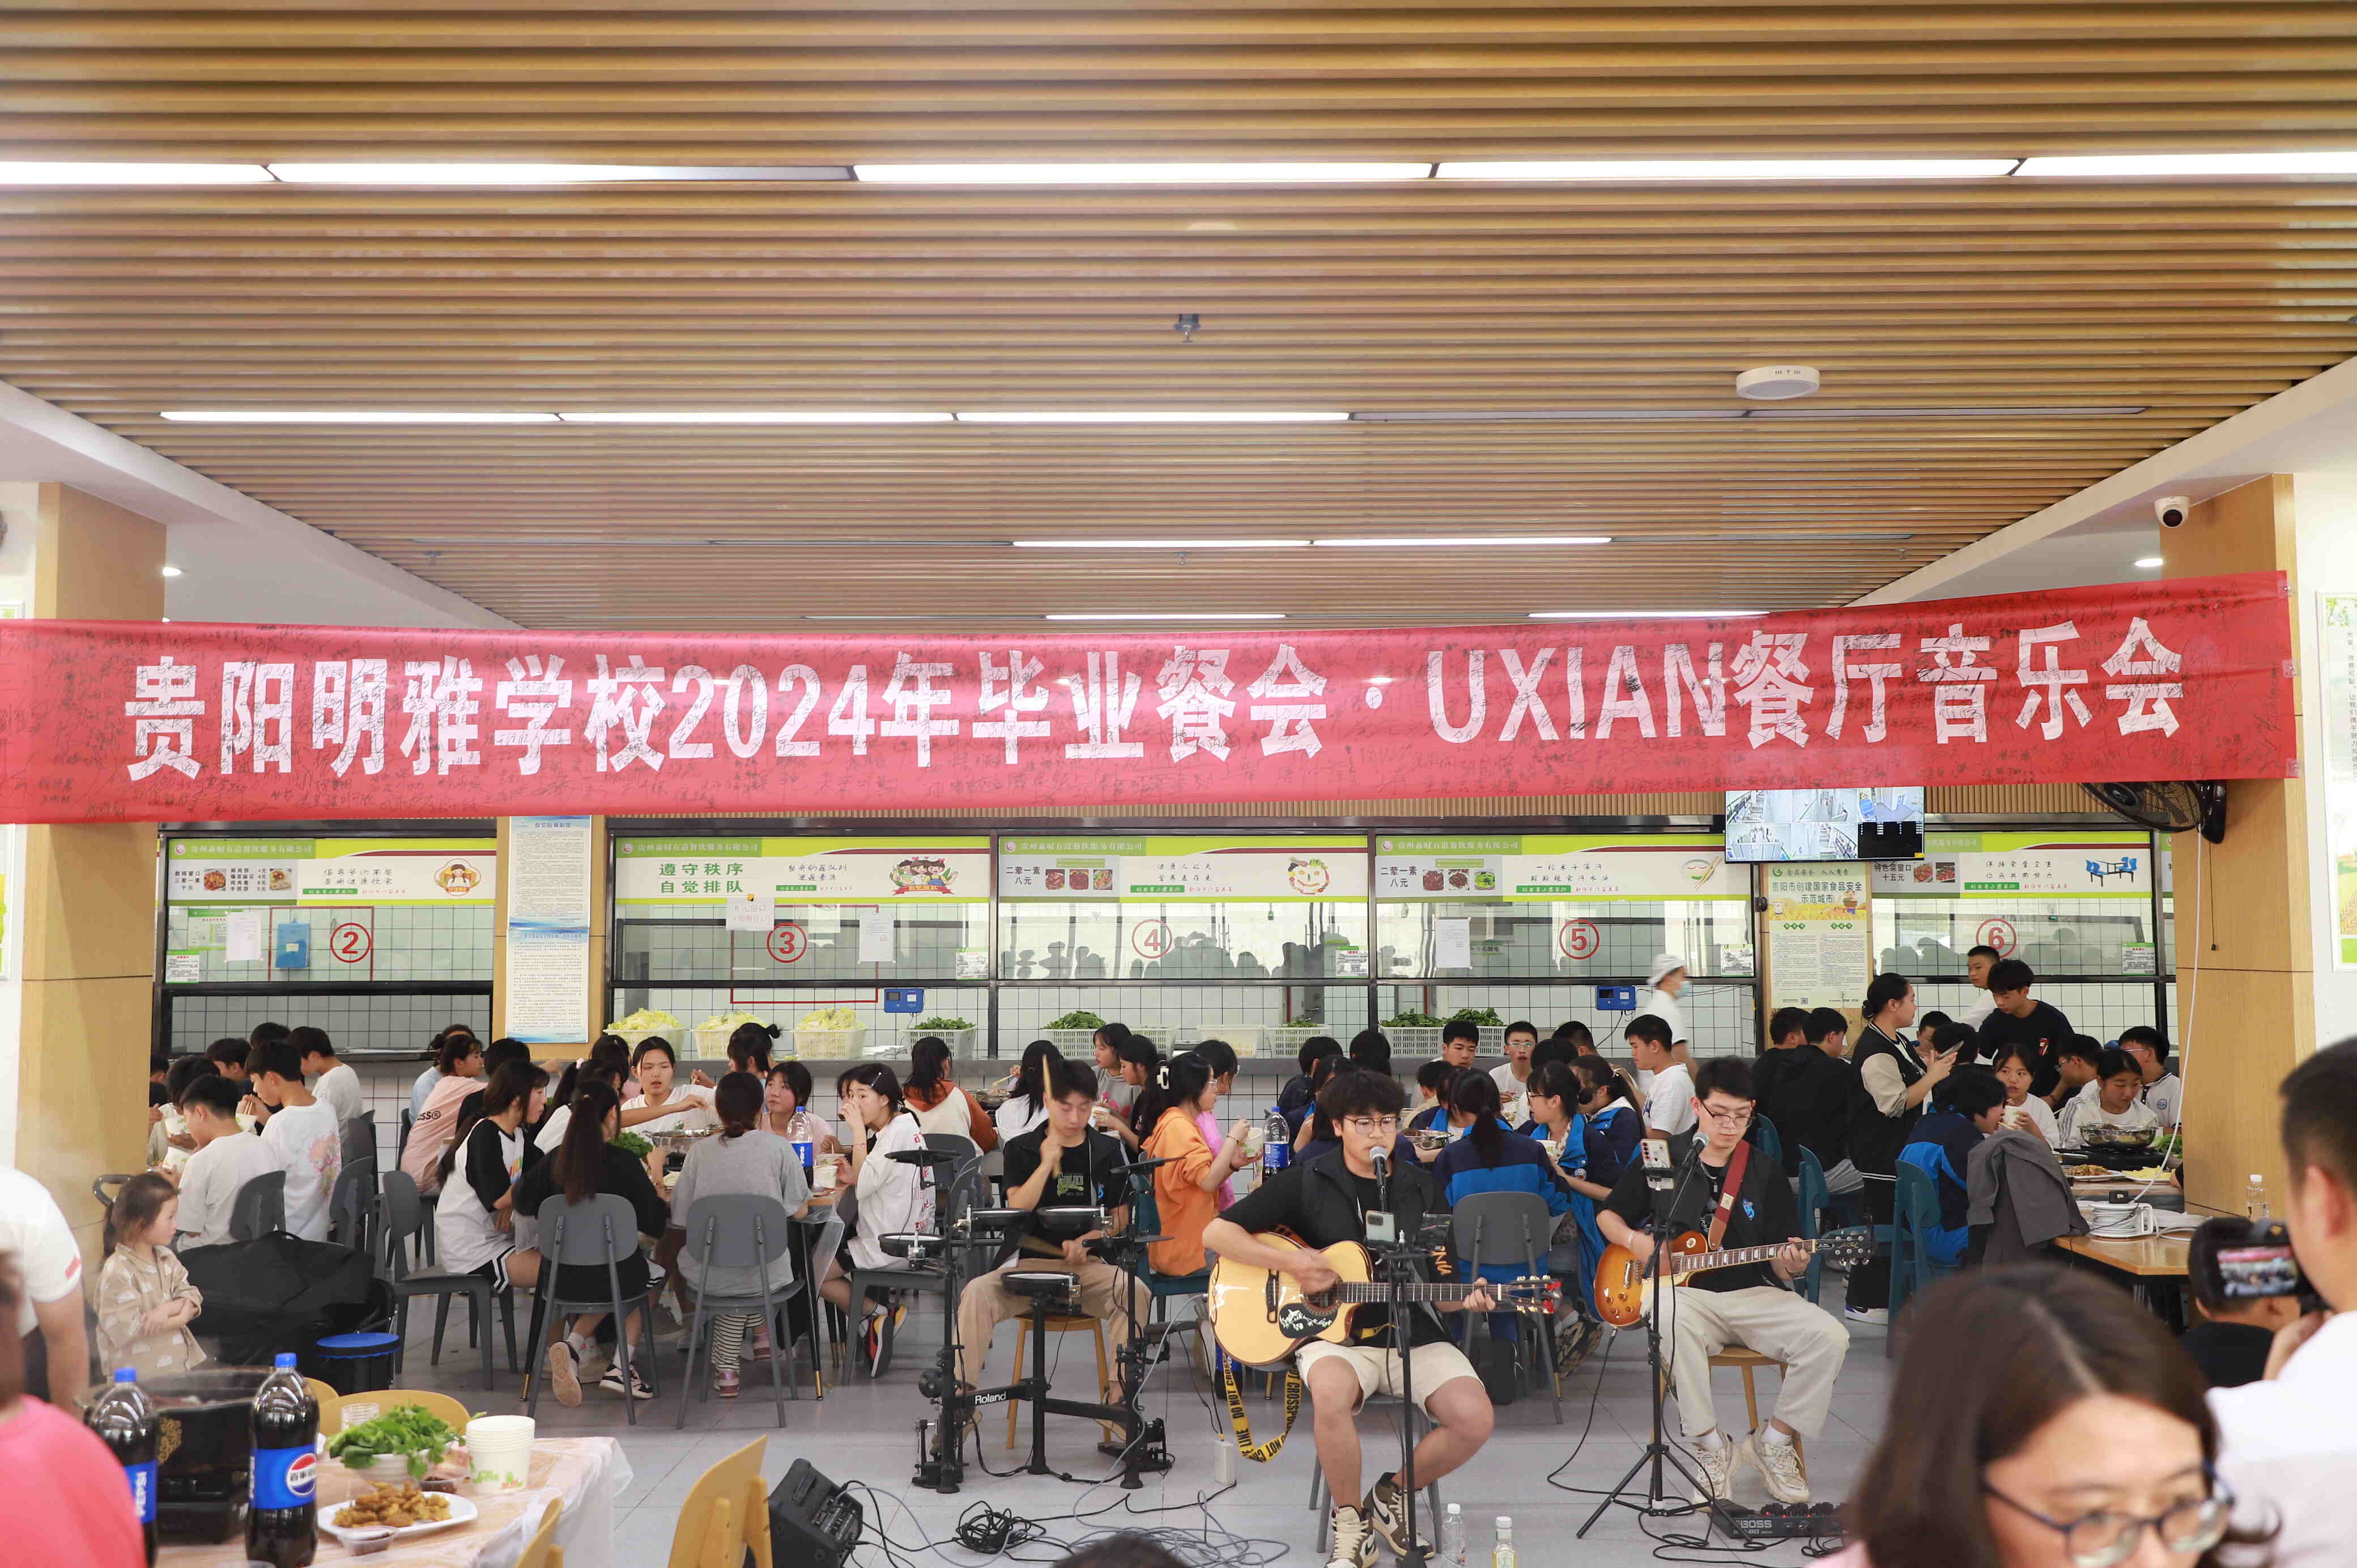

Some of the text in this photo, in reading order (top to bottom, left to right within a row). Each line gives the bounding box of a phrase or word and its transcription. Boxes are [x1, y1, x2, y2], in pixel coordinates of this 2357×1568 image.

[659, 863, 743, 876] 遵守秩序
[1006, 866, 1041, 875] 二荤一素
[1380, 866, 1417, 876] 二荤一素
[1015, 877, 1032, 885] 八元
[1390, 878, 1409, 888] 八元
[1882, 874, 1905, 882] 十五元
[661, 880, 743, 893] 自觉排队
[1772, 881, 1863, 892] 贵阳市创建国家食品安全
[1801, 894, 1834, 904] 示范城市
[975, 1391, 1006, 1404] Roland
[1227, 1390, 1240, 1405] NOT
[1287, 1382, 1300, 1410] CROSS
[1231, 1407, 1245, 1419] DO
[1236, 1428, 1253, 1447] LINE
[135, 1471, 147, 1516] PEPSI
[1740, 1520, 1772, 1528] BOSS
